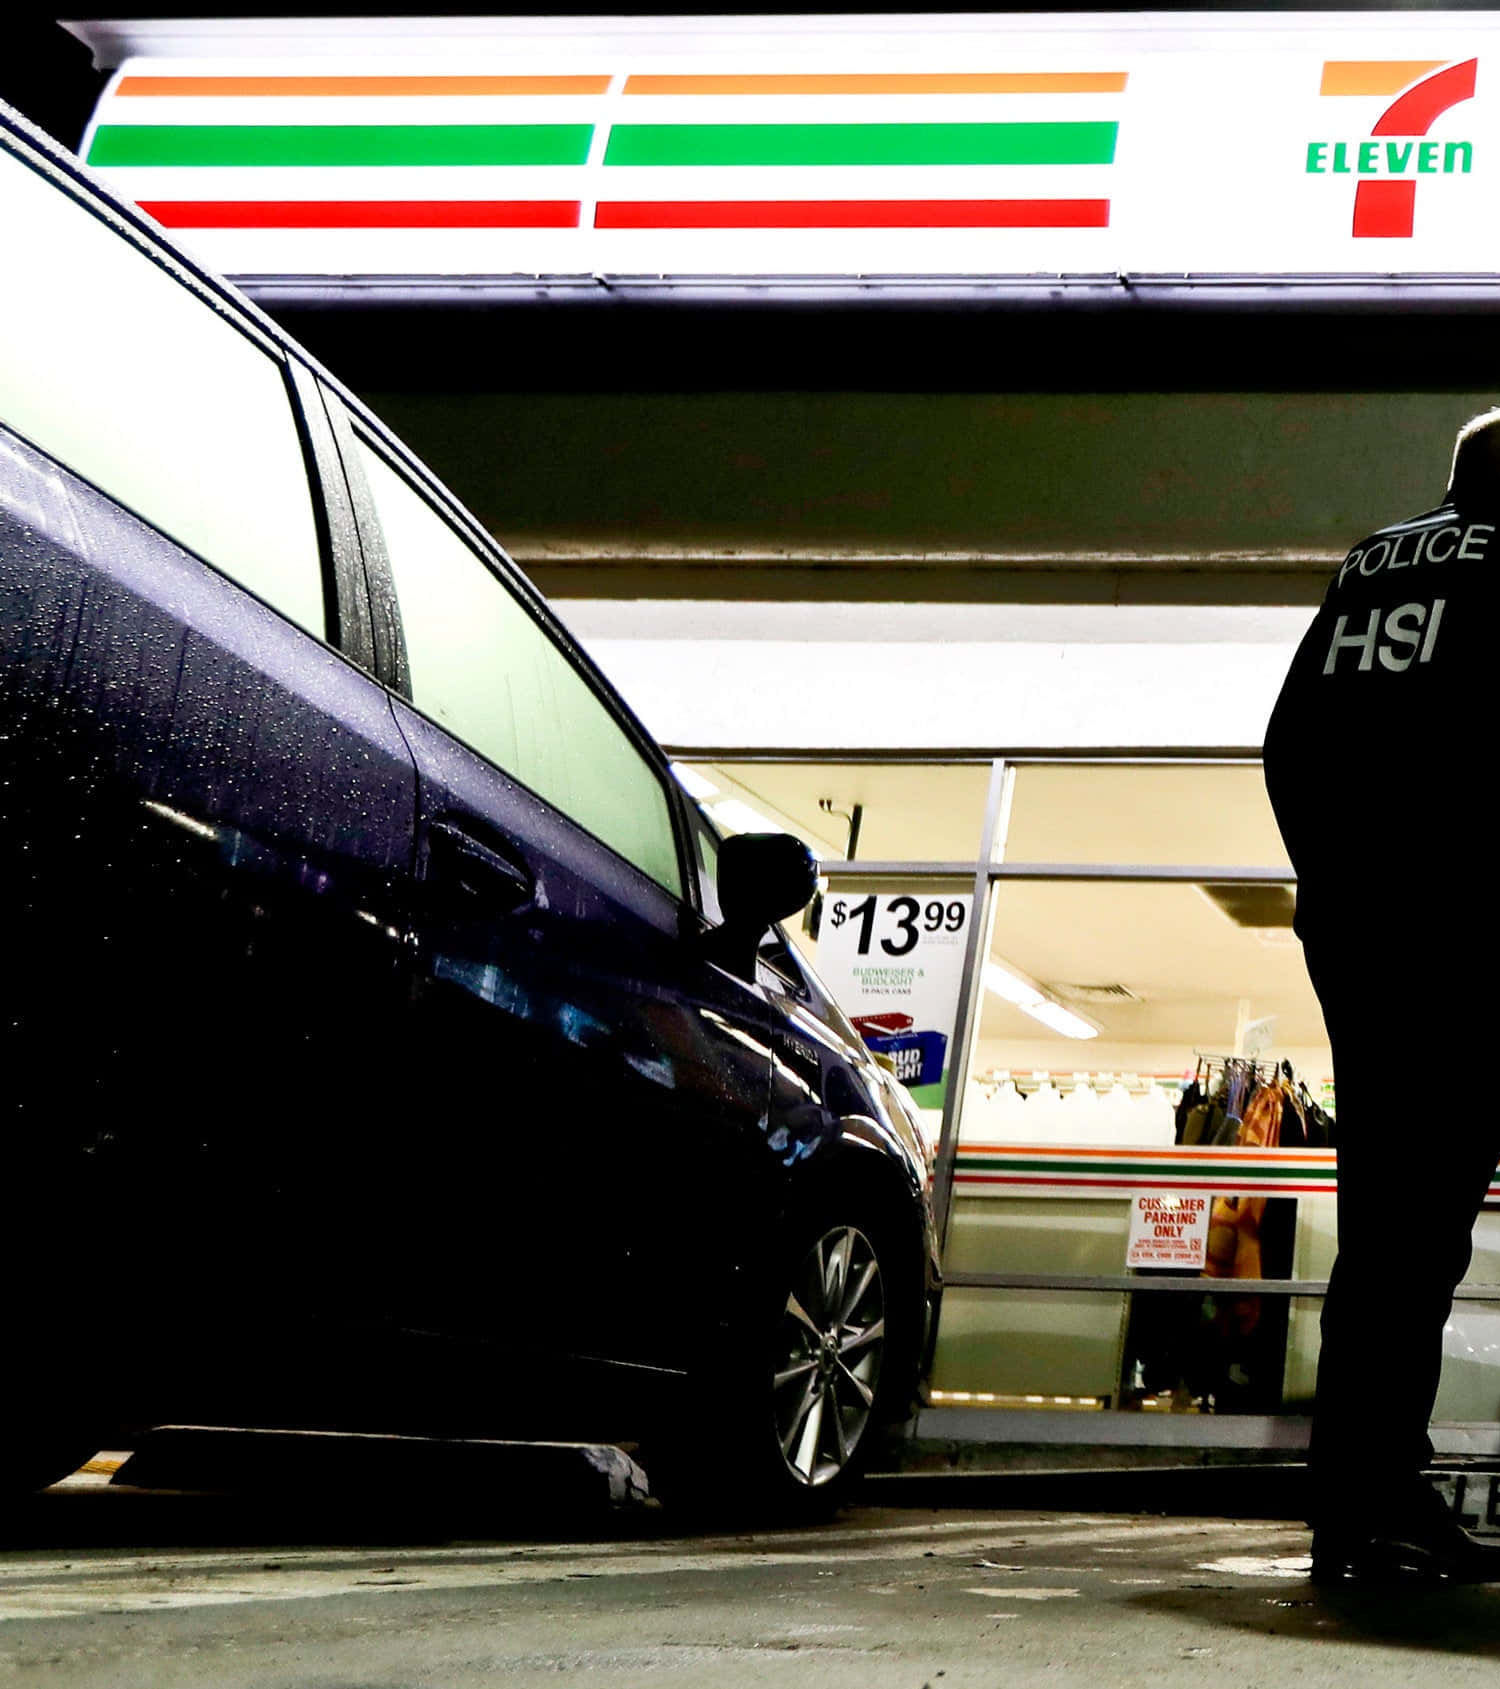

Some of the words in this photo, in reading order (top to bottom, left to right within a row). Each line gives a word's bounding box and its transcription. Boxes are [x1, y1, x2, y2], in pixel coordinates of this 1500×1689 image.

[1338, 523, 1496, 589] POLICE
[1322, 598, 1447, 675] HSI
[1138, 1196, 1206, 1211] CUSMER
[1144, 1211, 1198, 1225] PARKING
[1154, 1225, 1184, 1238] ONLY
